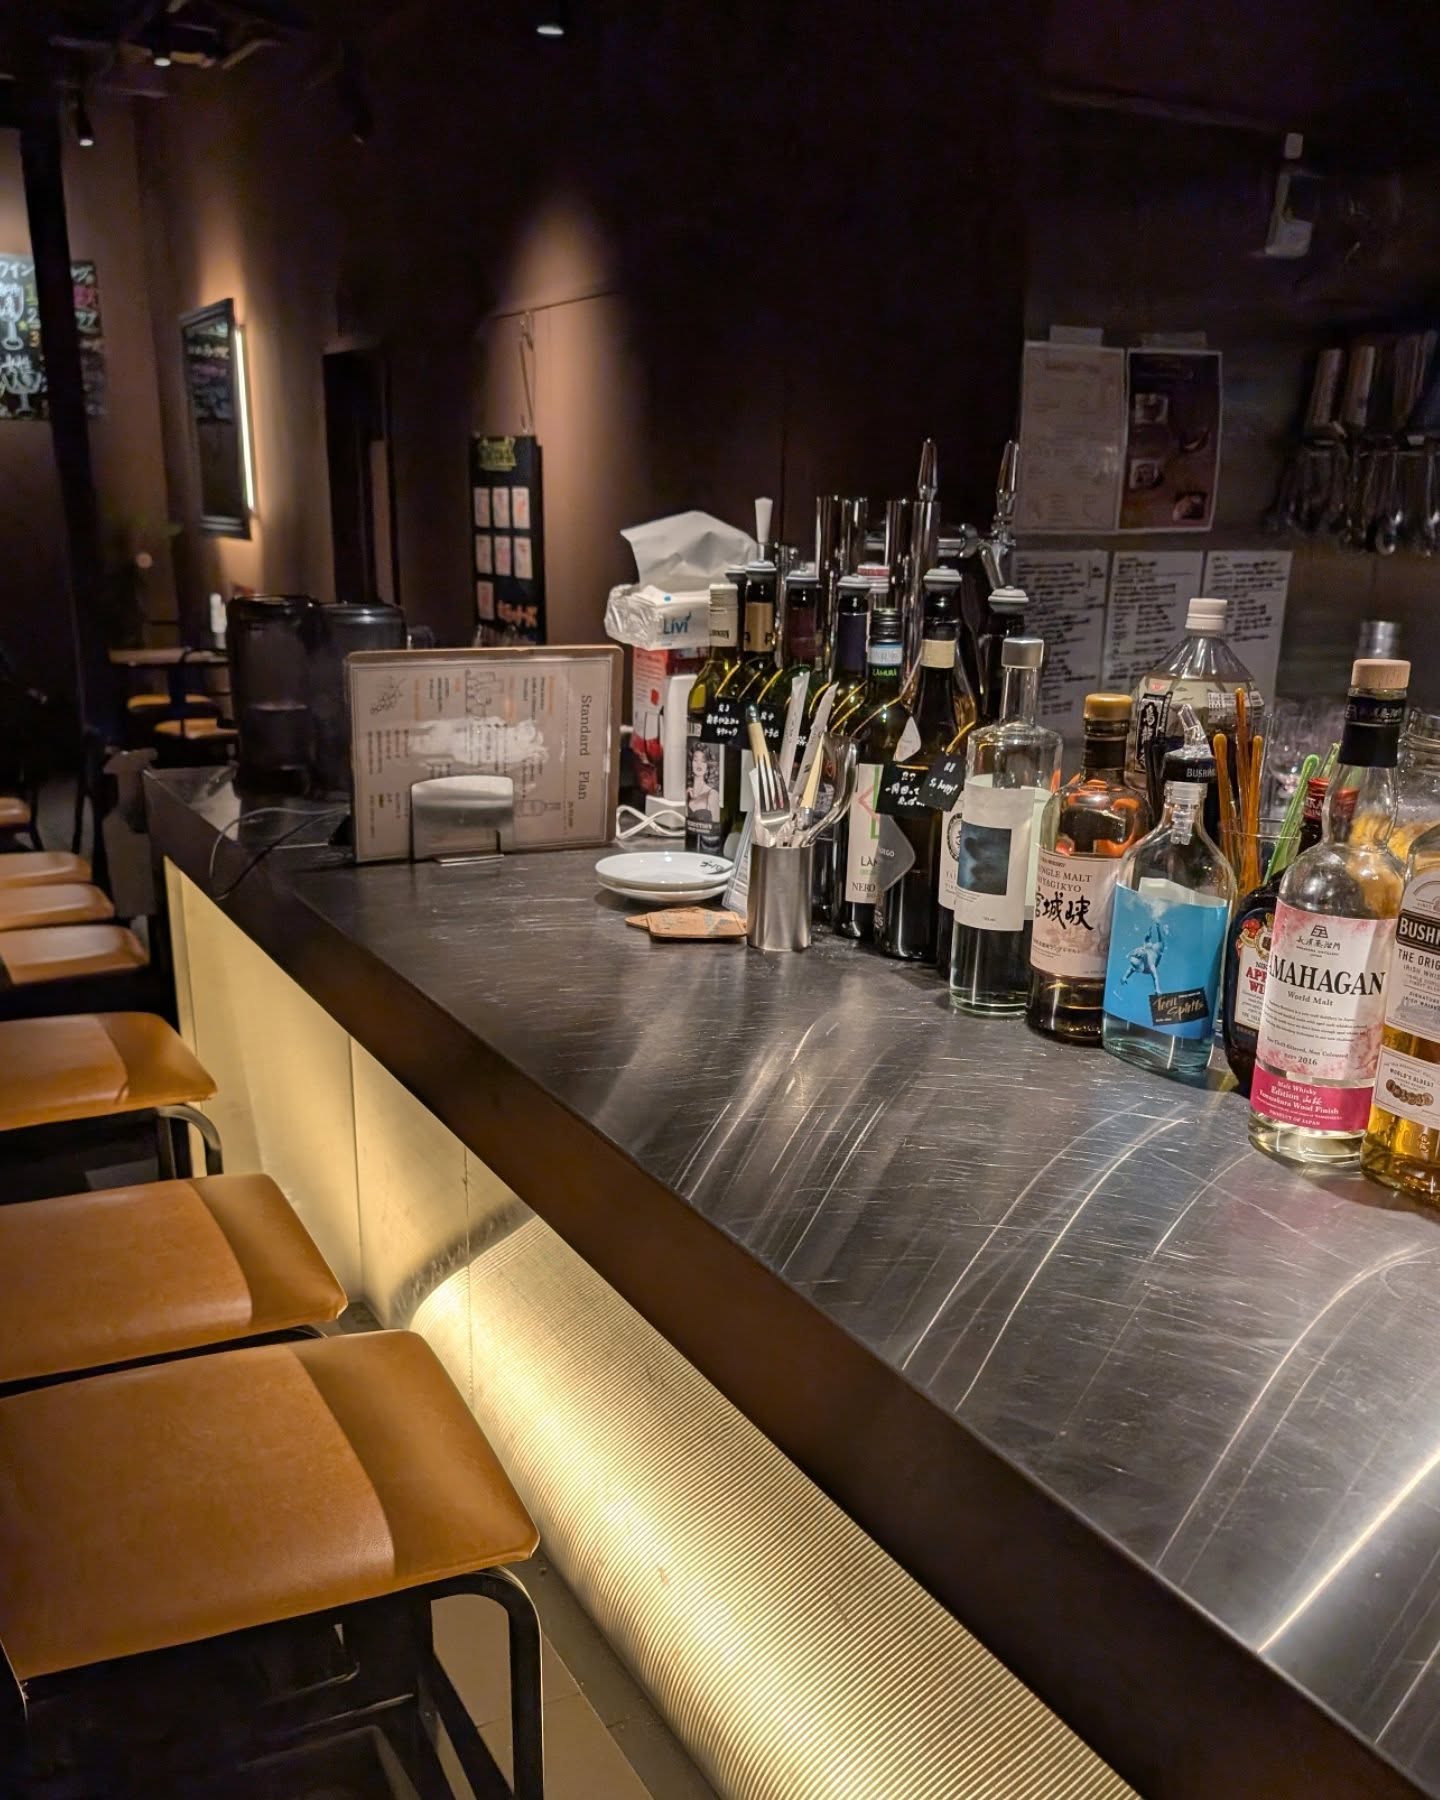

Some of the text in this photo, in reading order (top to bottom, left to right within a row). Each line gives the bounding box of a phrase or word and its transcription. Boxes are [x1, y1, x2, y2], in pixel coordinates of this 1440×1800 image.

[578, 695, 593, 800] Standard Plan
[1186, 768, 1216, 778] BUSHM
[1063, 872, 1093, 883] MALT
[1398, 948, 1415, 963] THE
[1287, 990, 1334, 1006] World Malt
[1298, 1055, 1318, 1066] 2016
[1271, 1086, 1299, 1101] Edition
